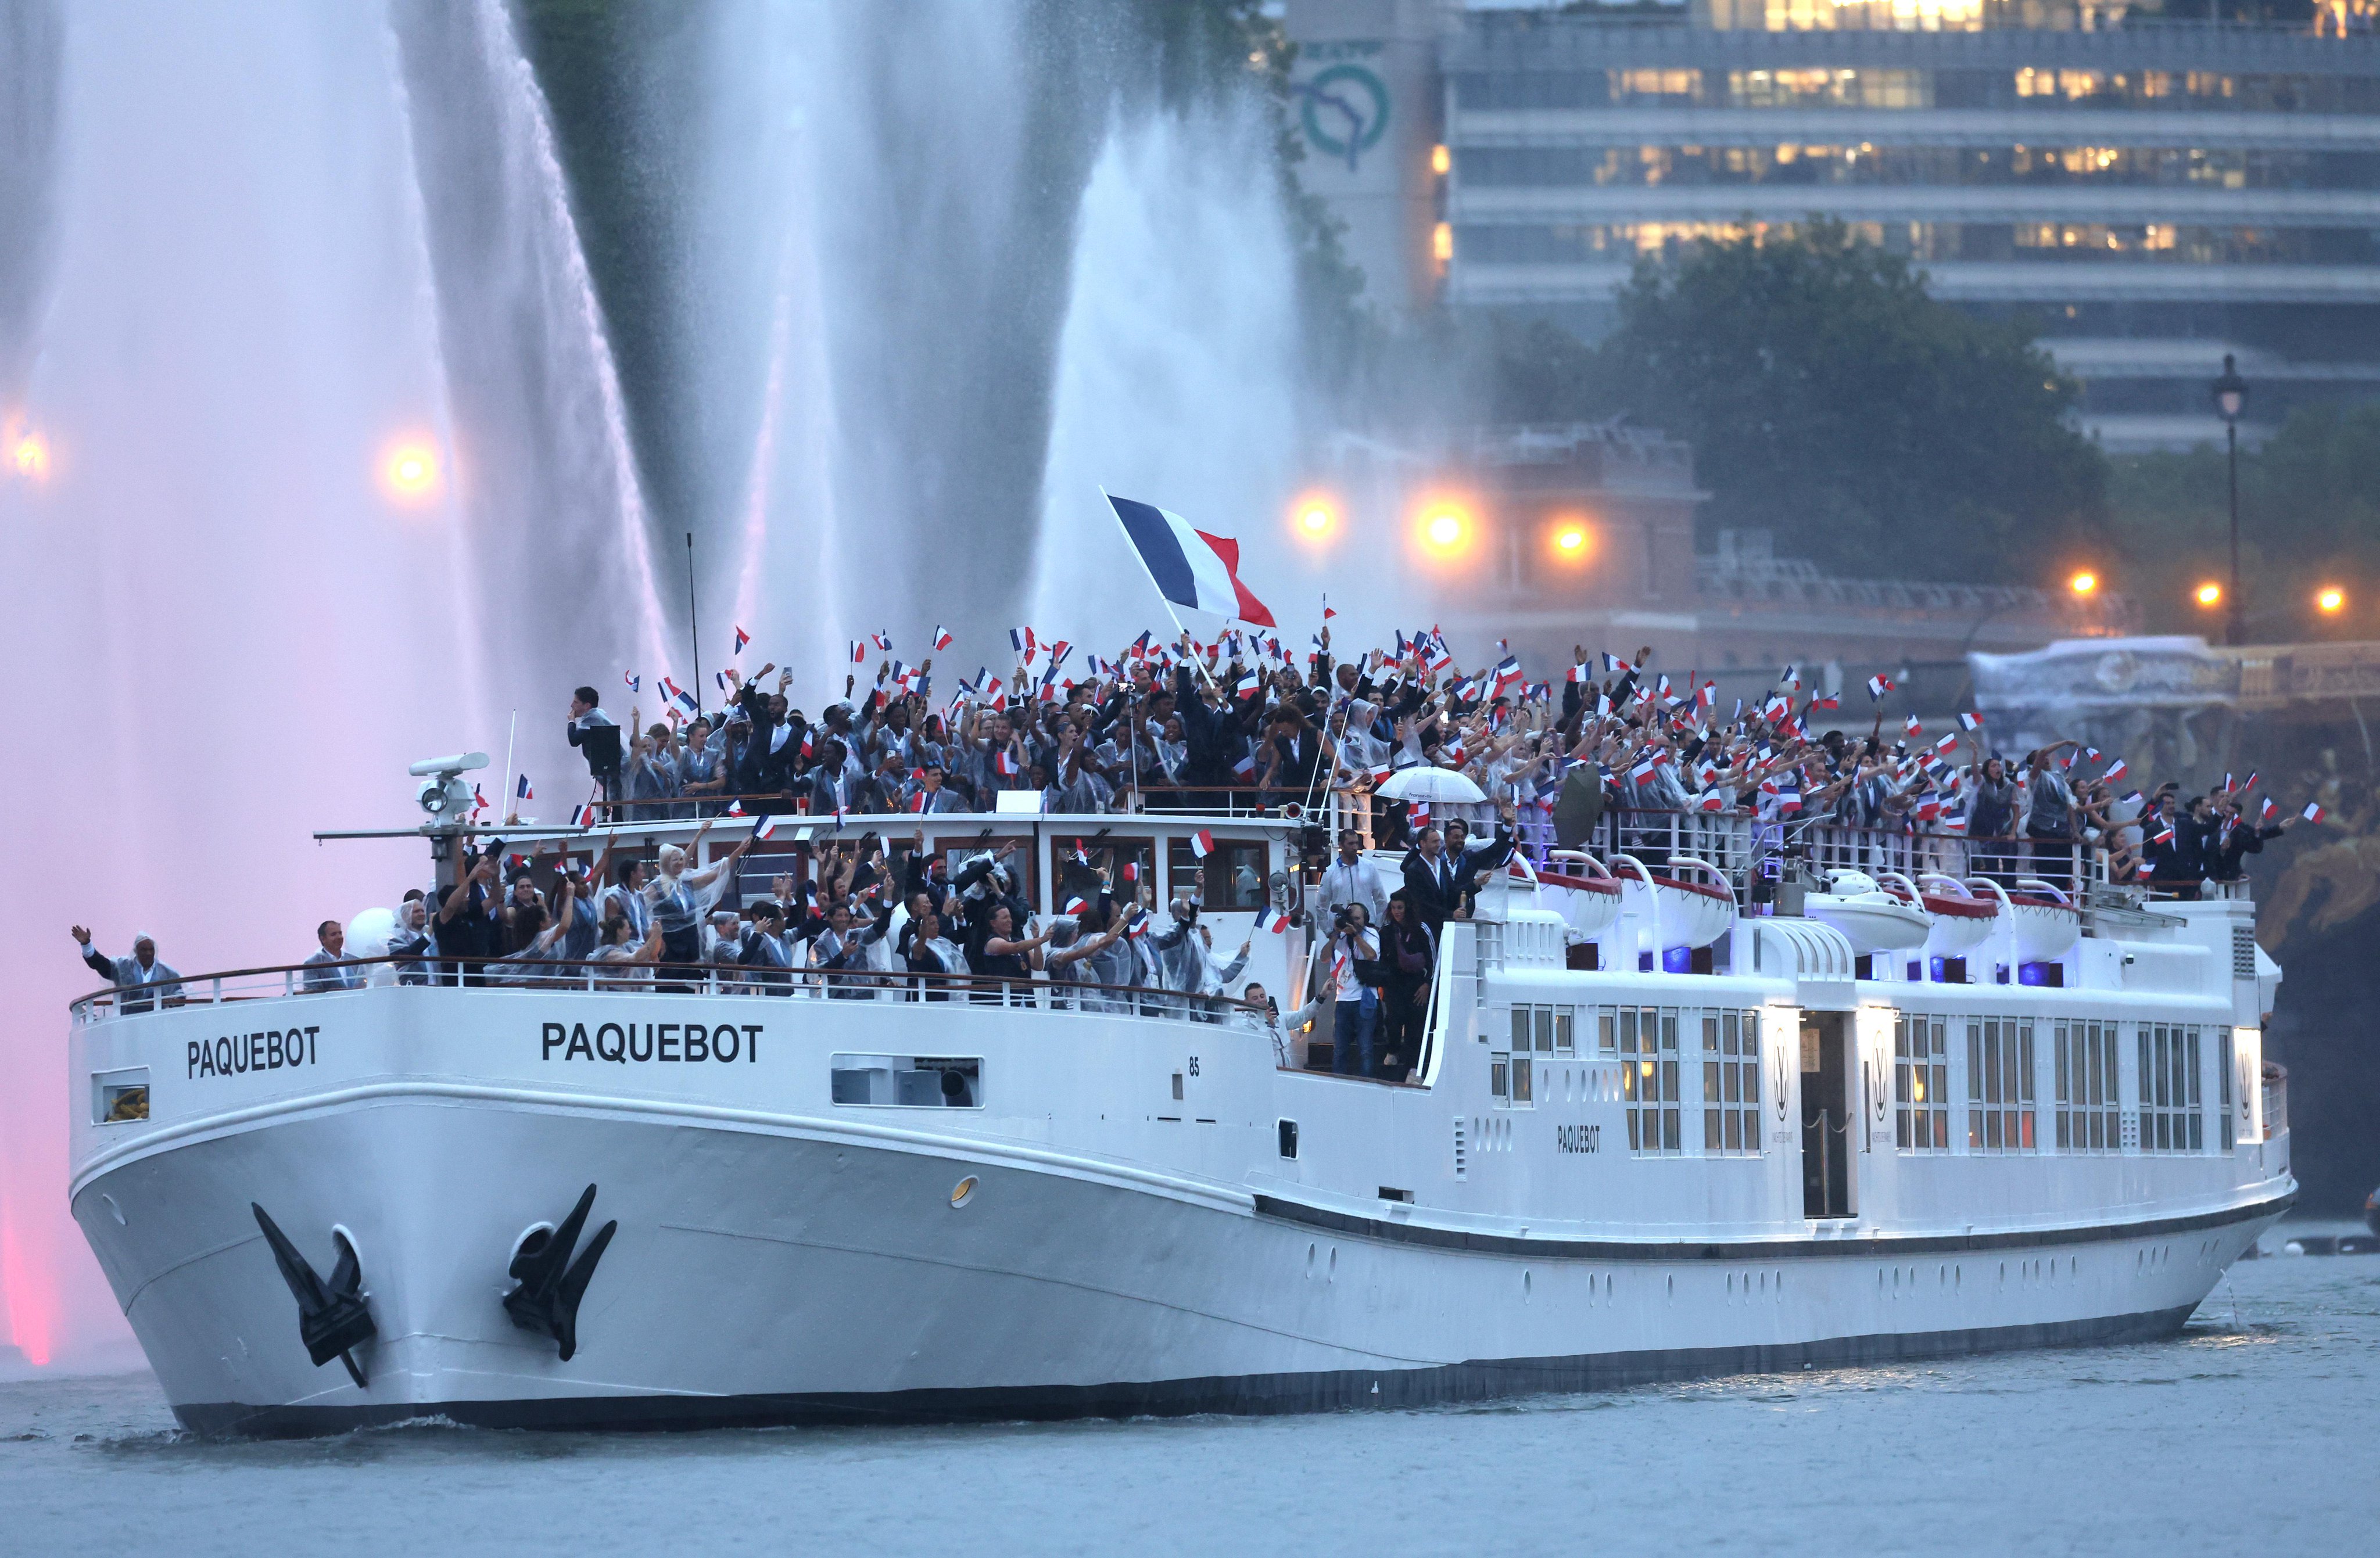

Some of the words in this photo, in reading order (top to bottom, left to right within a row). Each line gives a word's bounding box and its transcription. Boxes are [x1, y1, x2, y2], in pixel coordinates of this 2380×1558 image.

[188, 1026, 320, 1079] PAQUEBOT
[542, 1022, 764, 1065] PAQUEBOT
[1189, 1056, 1199, 1077] 85
[1558, 1125, 1600, 1154] PAQUEBOT
